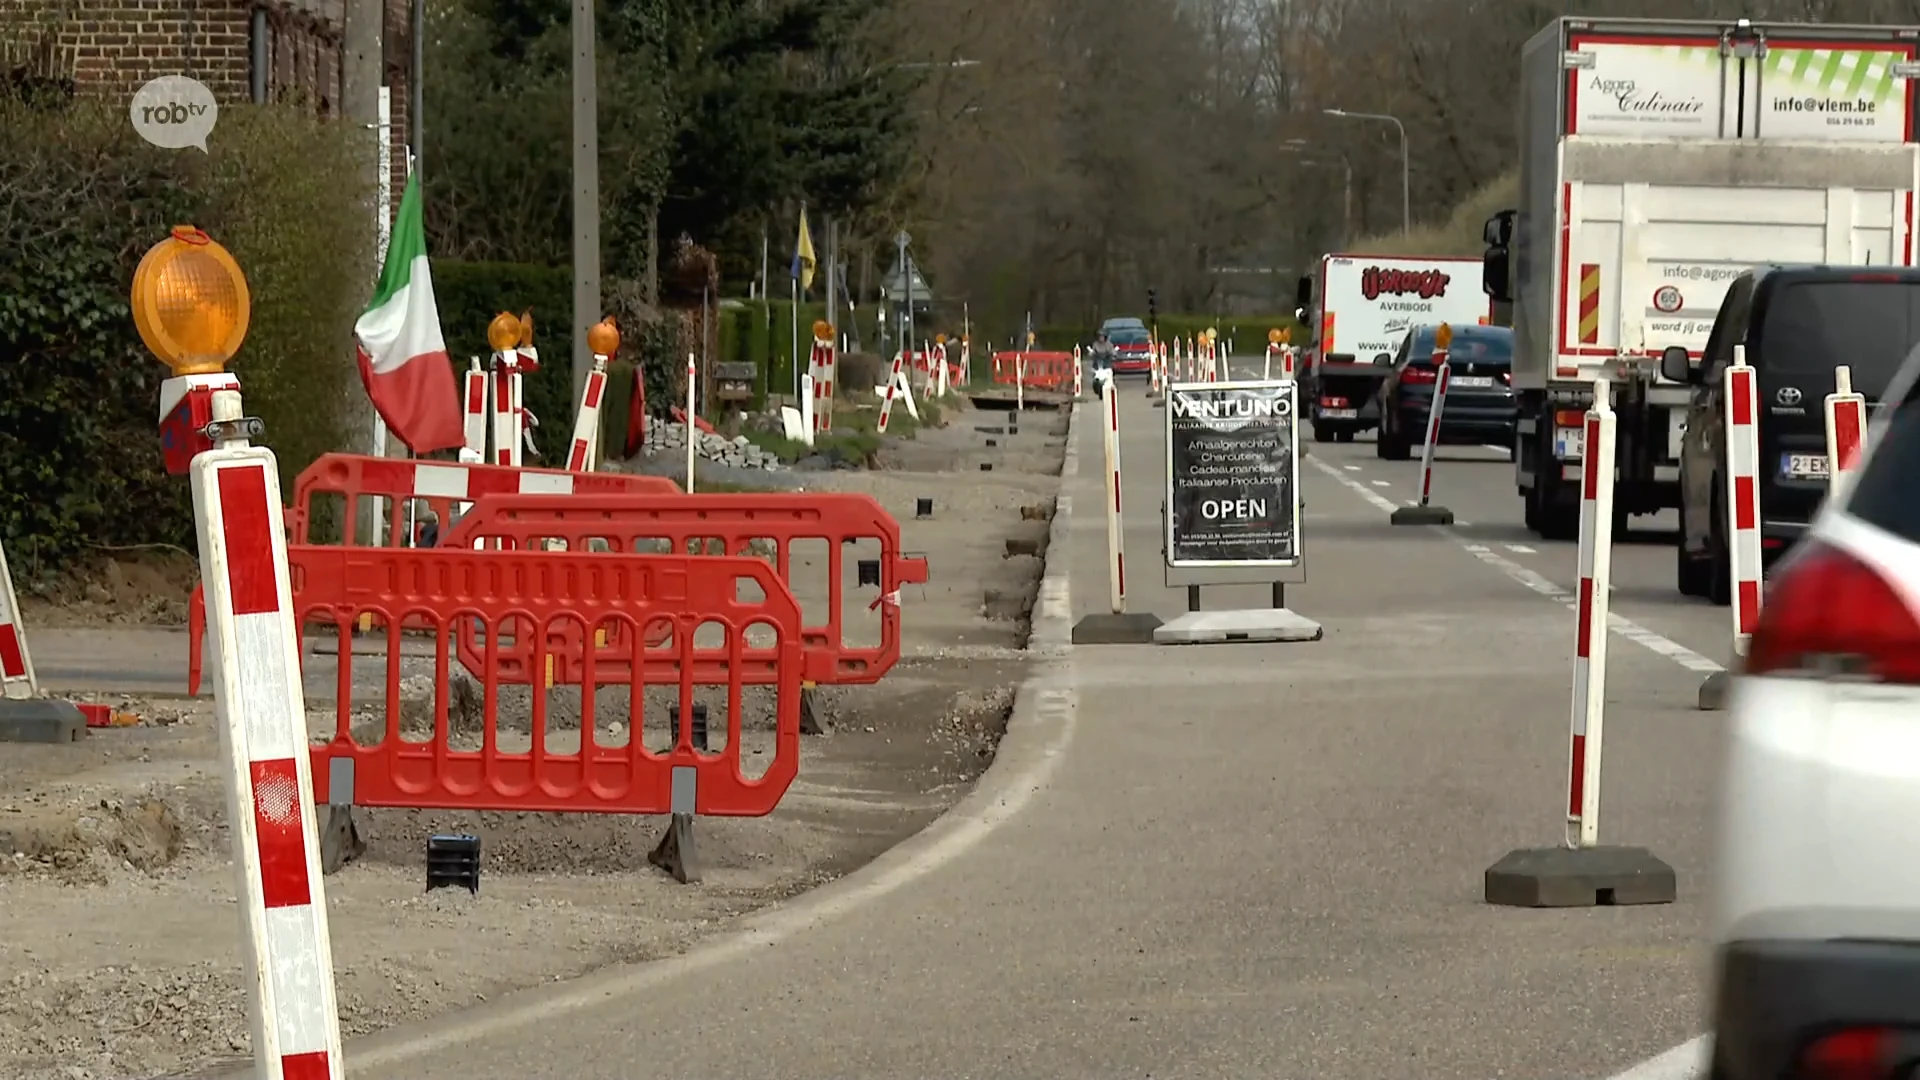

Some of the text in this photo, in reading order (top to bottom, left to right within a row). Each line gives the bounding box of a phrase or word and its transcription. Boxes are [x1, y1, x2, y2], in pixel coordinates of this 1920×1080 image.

[1589, 75, 1636, 94] Agora
[1614, 87, 1704, 113] Culinair
[1773, 97, 1876, 113] info@vlem.be
[1663, 265, 1742, 281] info@agora
[1660, 292, 1677, 303] 60
[1380, 302, 1433, 312] AVERBODE
[1652, 322, 1681, 332] word
[1696, 324, 1712, 333] on
[1358, 342, 1403, 353] www.ij
[1172, 398, 1291, 418] VENTUNO
[1187, 440, 1278, 452] Afhaalgerechten
[1179, 476, 1288, 488] Italiaanse Producten
[1201, 498, 1267, 520] OPEN
